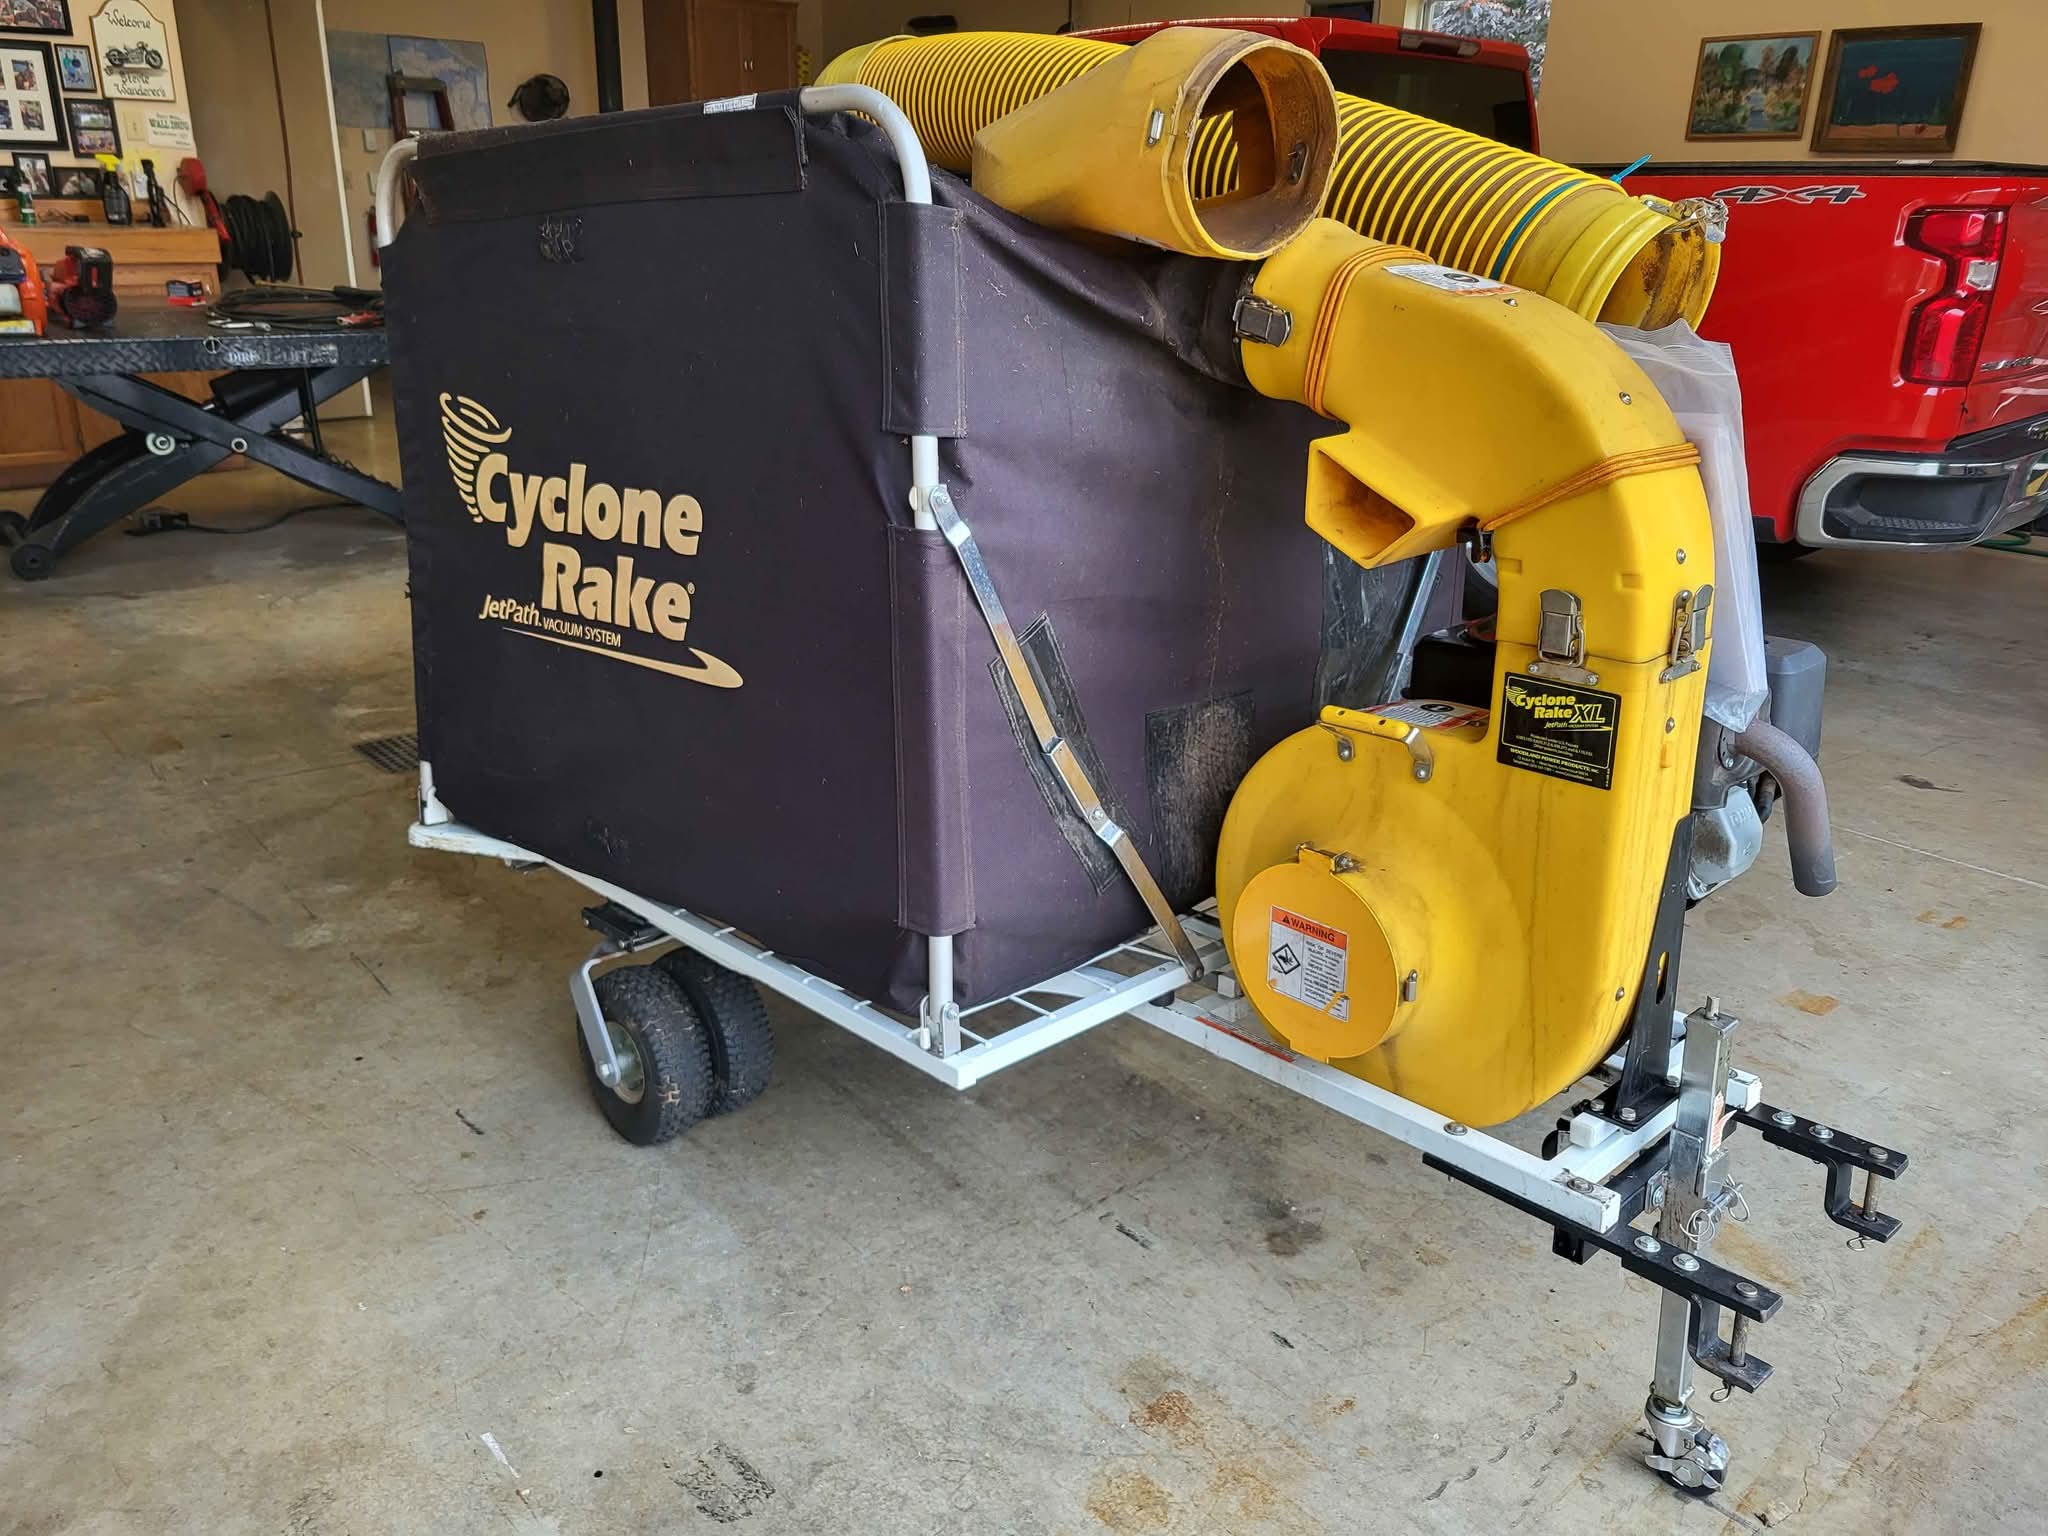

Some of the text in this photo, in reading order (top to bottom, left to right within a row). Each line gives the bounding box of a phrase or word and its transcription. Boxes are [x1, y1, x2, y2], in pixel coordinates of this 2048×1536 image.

[104, 8, 151, 29] Welcome
[476, 453, 703, 556] Cyclone
[543, 616, 583, 638] VACUUM
[584, 626, 621, 648] SYSTEM
[1516, 694, 1576, 710] Cyclone
[1534, 704, 1606, 724] Rake XL
[1291, 917, 1335, 943] WARNING
